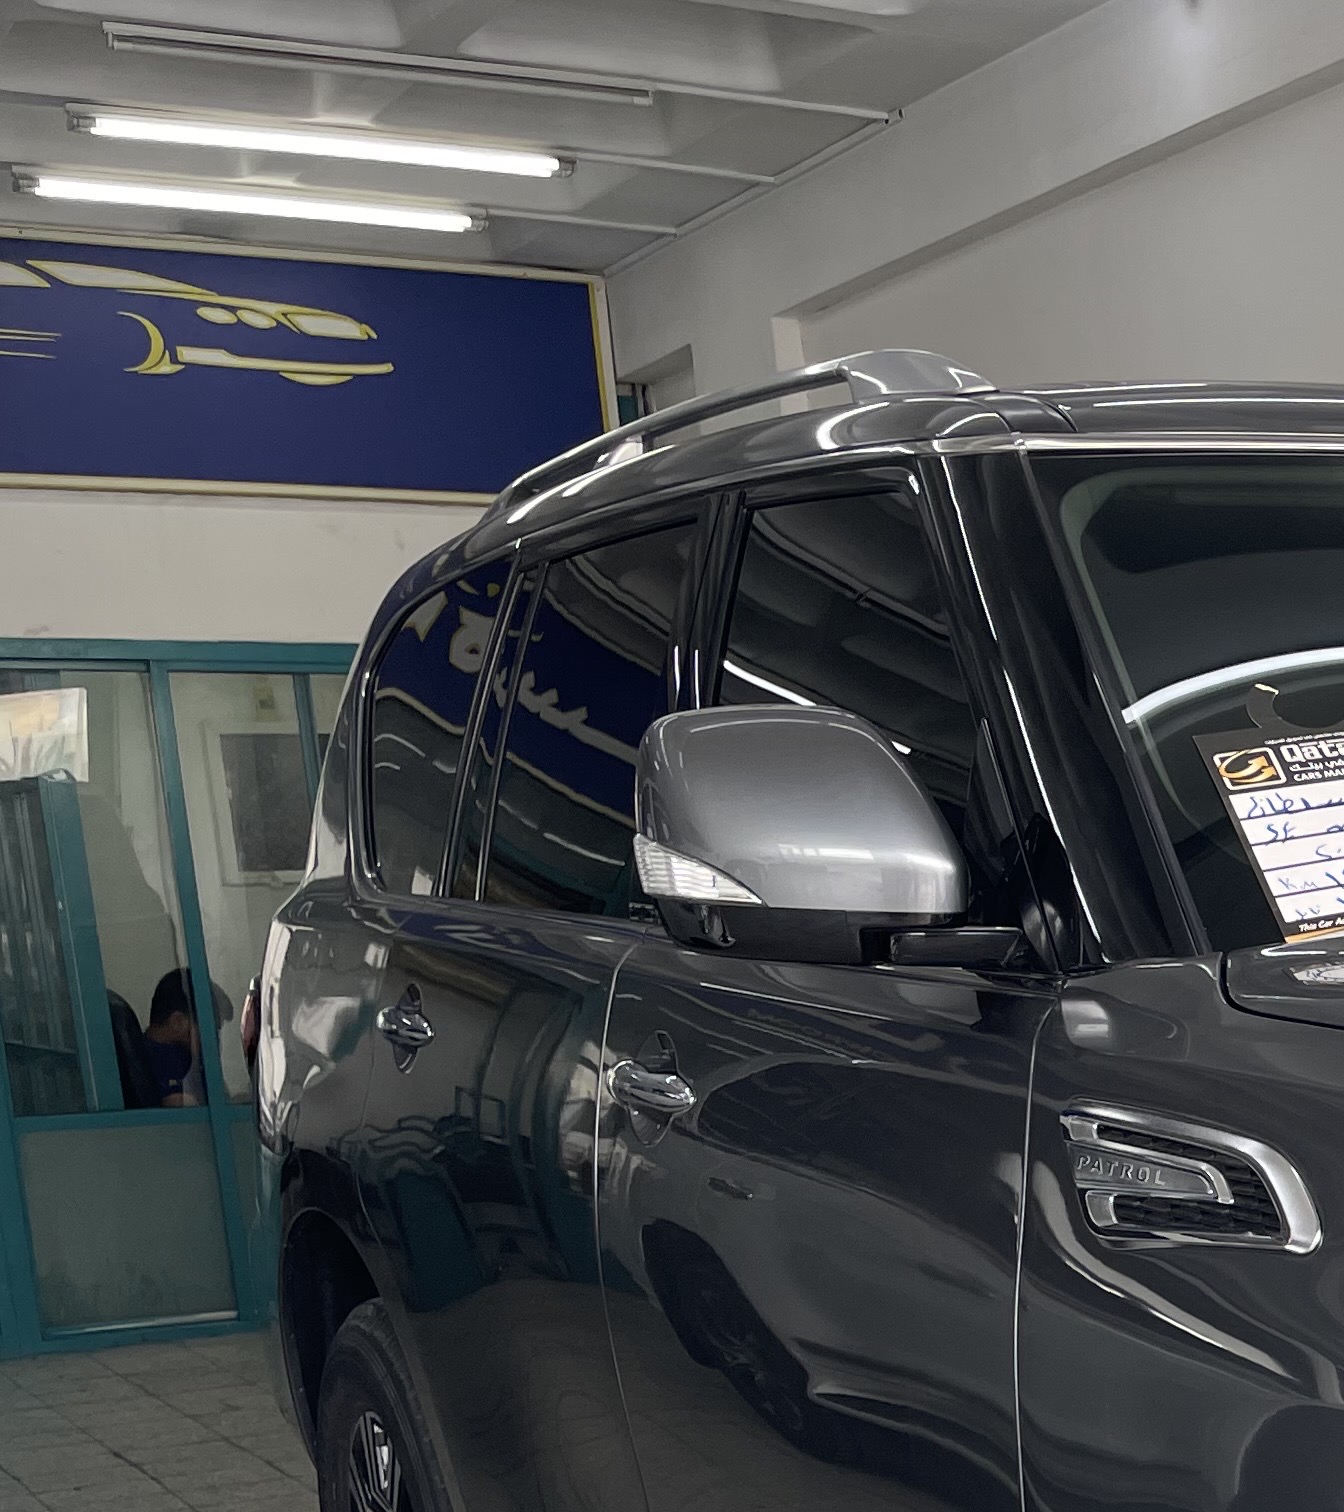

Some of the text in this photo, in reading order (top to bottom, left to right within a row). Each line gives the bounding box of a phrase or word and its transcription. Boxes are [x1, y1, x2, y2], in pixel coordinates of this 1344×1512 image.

[1293, 773, 1323, 782] CARS
[1299, 923, 1318, 932] This
[1318, 920, 1334, 928] Car
[1076, 1154, 1166, 1187] PATROL
